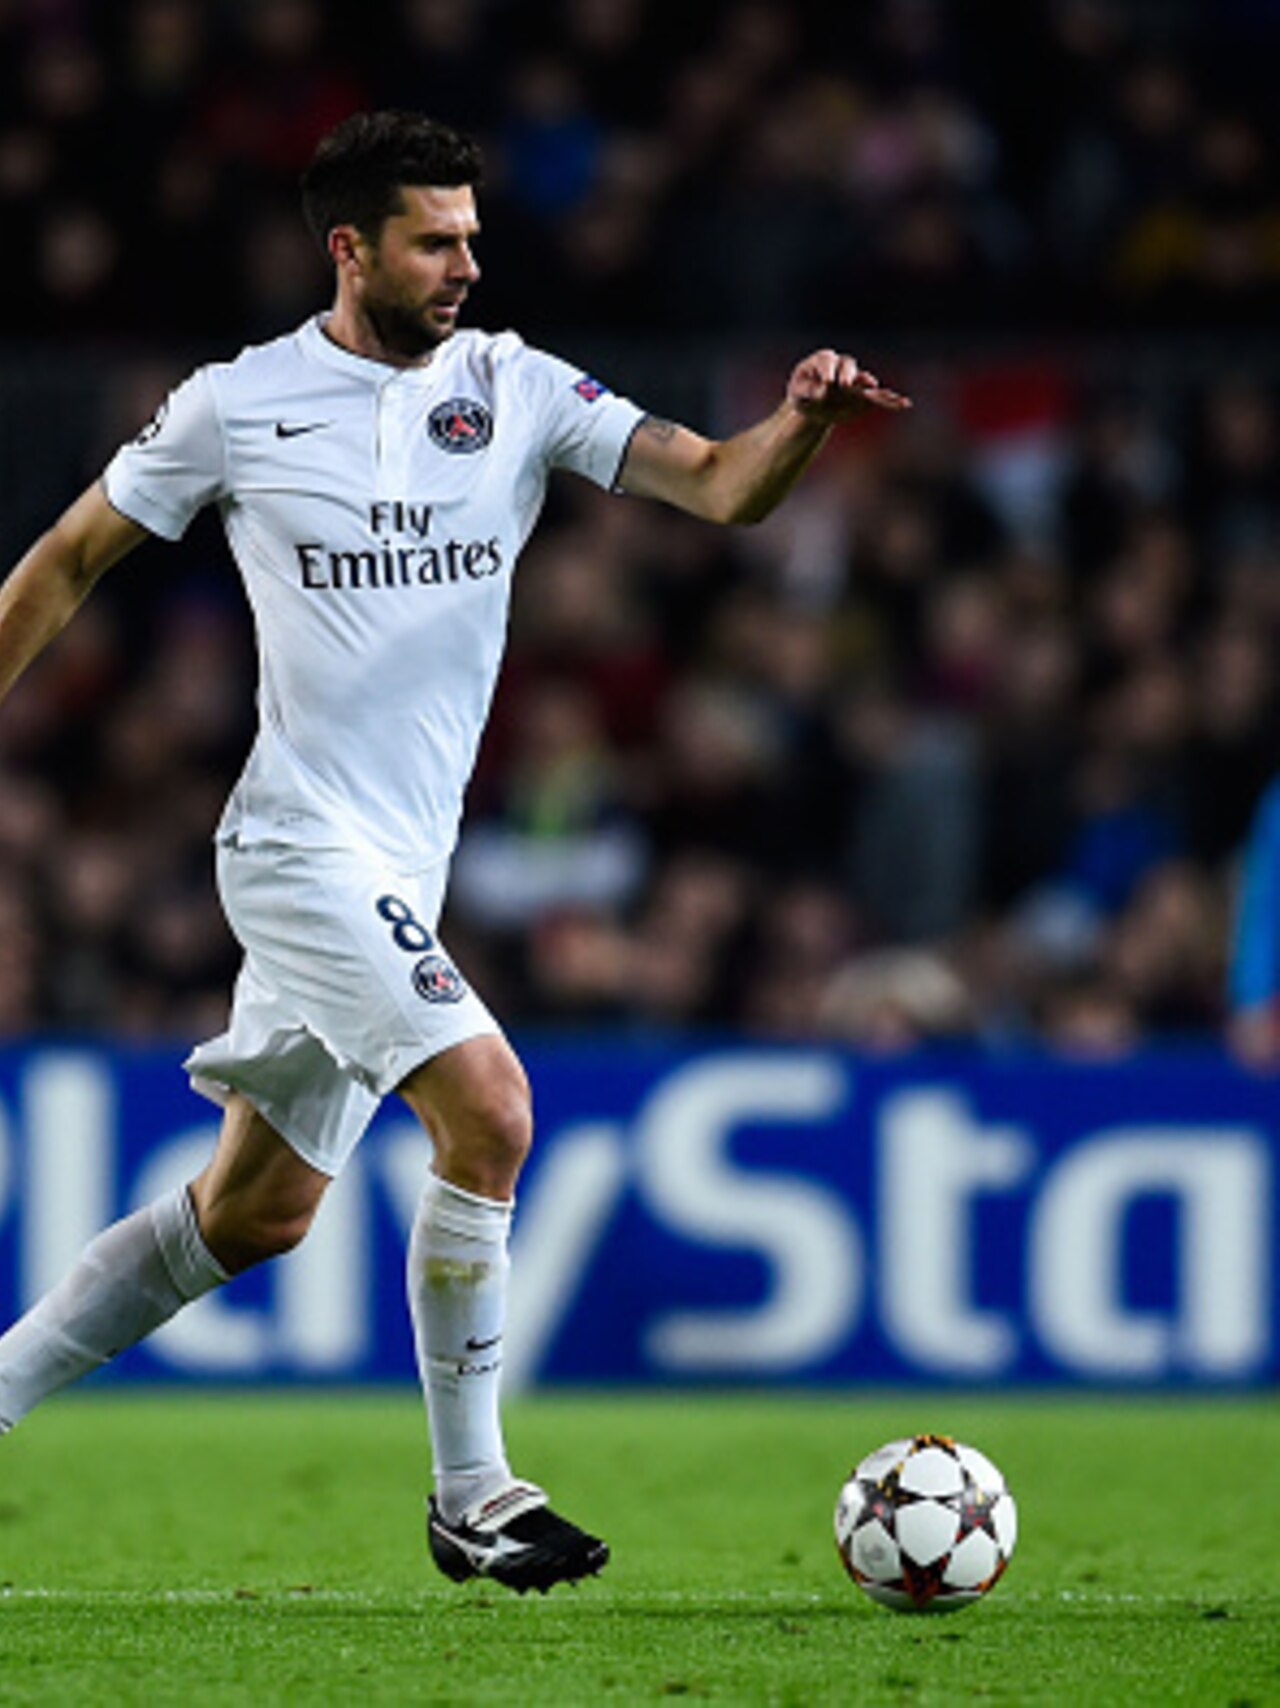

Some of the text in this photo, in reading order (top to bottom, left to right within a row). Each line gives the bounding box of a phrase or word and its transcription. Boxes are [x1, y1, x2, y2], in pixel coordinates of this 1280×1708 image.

[370, 501, 433, 538] Fly
[294, 537, 503, 589] Emirates
[375, 893, 434, 952] 8
